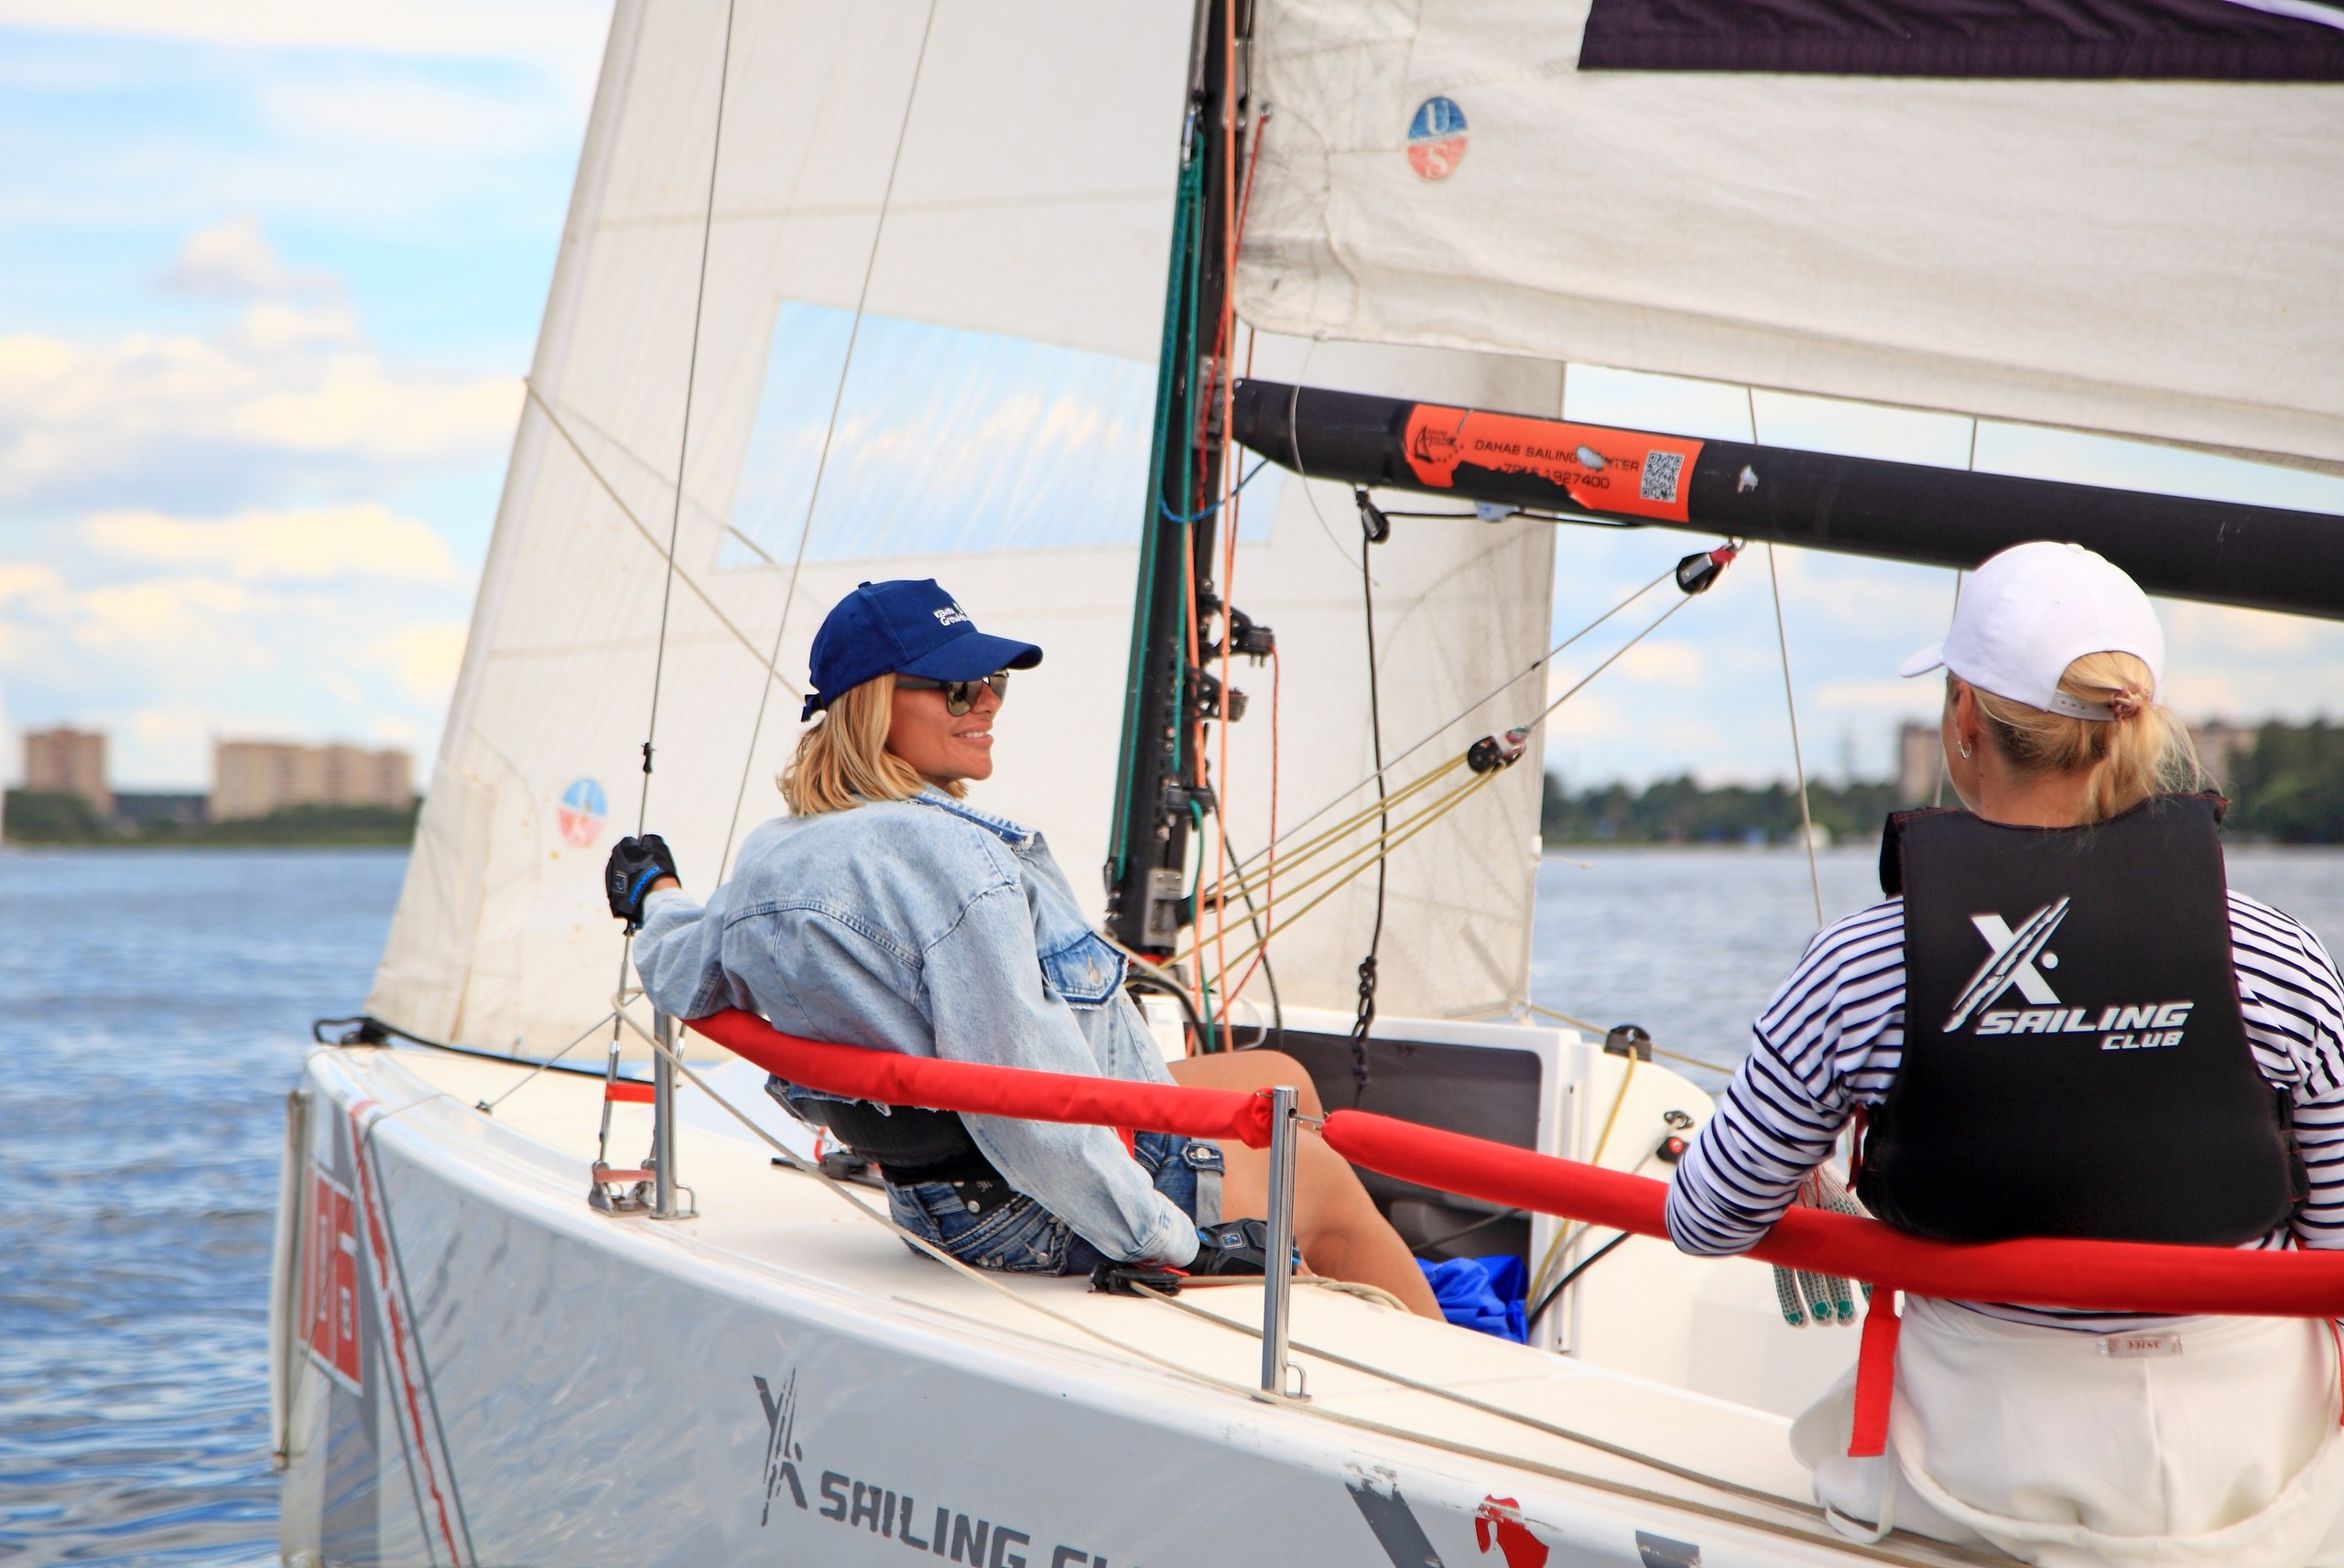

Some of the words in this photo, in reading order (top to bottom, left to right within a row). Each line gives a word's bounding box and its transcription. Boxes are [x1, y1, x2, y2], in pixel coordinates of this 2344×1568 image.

[1425, 100, 1449, 135] U
[1426, 144, 1449, 177] S
[1474, 439, 1521, 456] DAHAB
[1525, 446, 1578, 464] SAILING
[1544, 469, 1611, 490] 1927400
[1975, 1001, 2195, 1035] SAILING
[2101, 1031, 2185, 1051] CLUB
[819, 1469, 1031, 1568] SAILING
